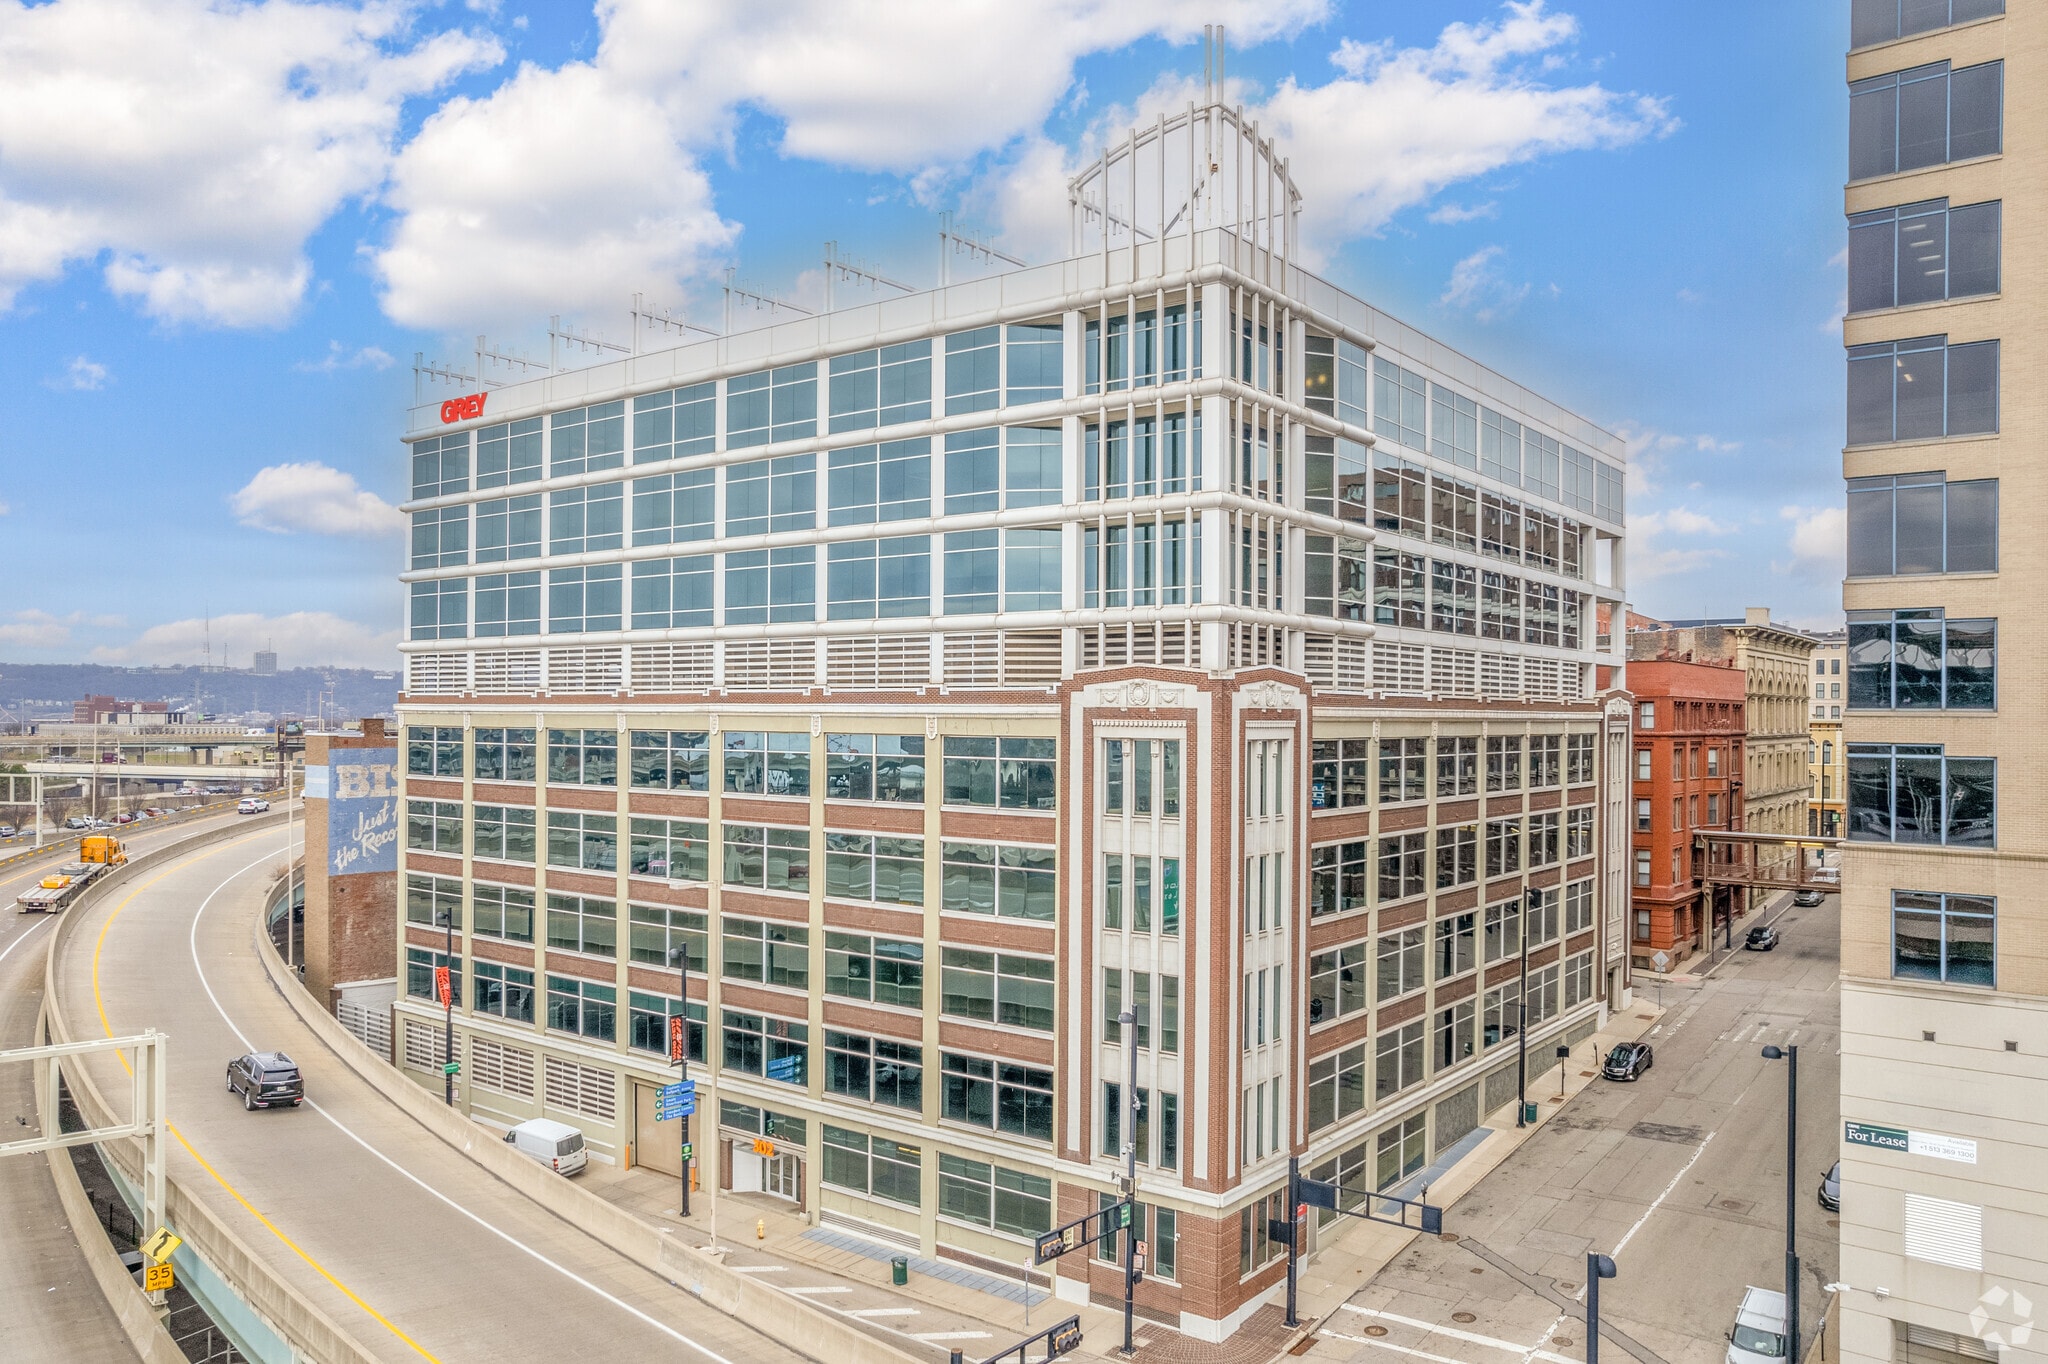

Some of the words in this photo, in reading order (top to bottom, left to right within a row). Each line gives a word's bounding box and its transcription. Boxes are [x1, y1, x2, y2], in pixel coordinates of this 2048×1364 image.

[441, 392, 488, 424] GREY
[352, 800, 390, 841] Just
[334, 845, 359, 871] the
[361, 826, 398, 858] Reco
[753, 1138, 775, 1157] 302
[1848, 1129, 1869, 1141] For
[1870, 1132, 1907, 1148] Lease
[1957, 1150, 1975, 1159] 1300
[150, 1267, 170, 1280] 35
